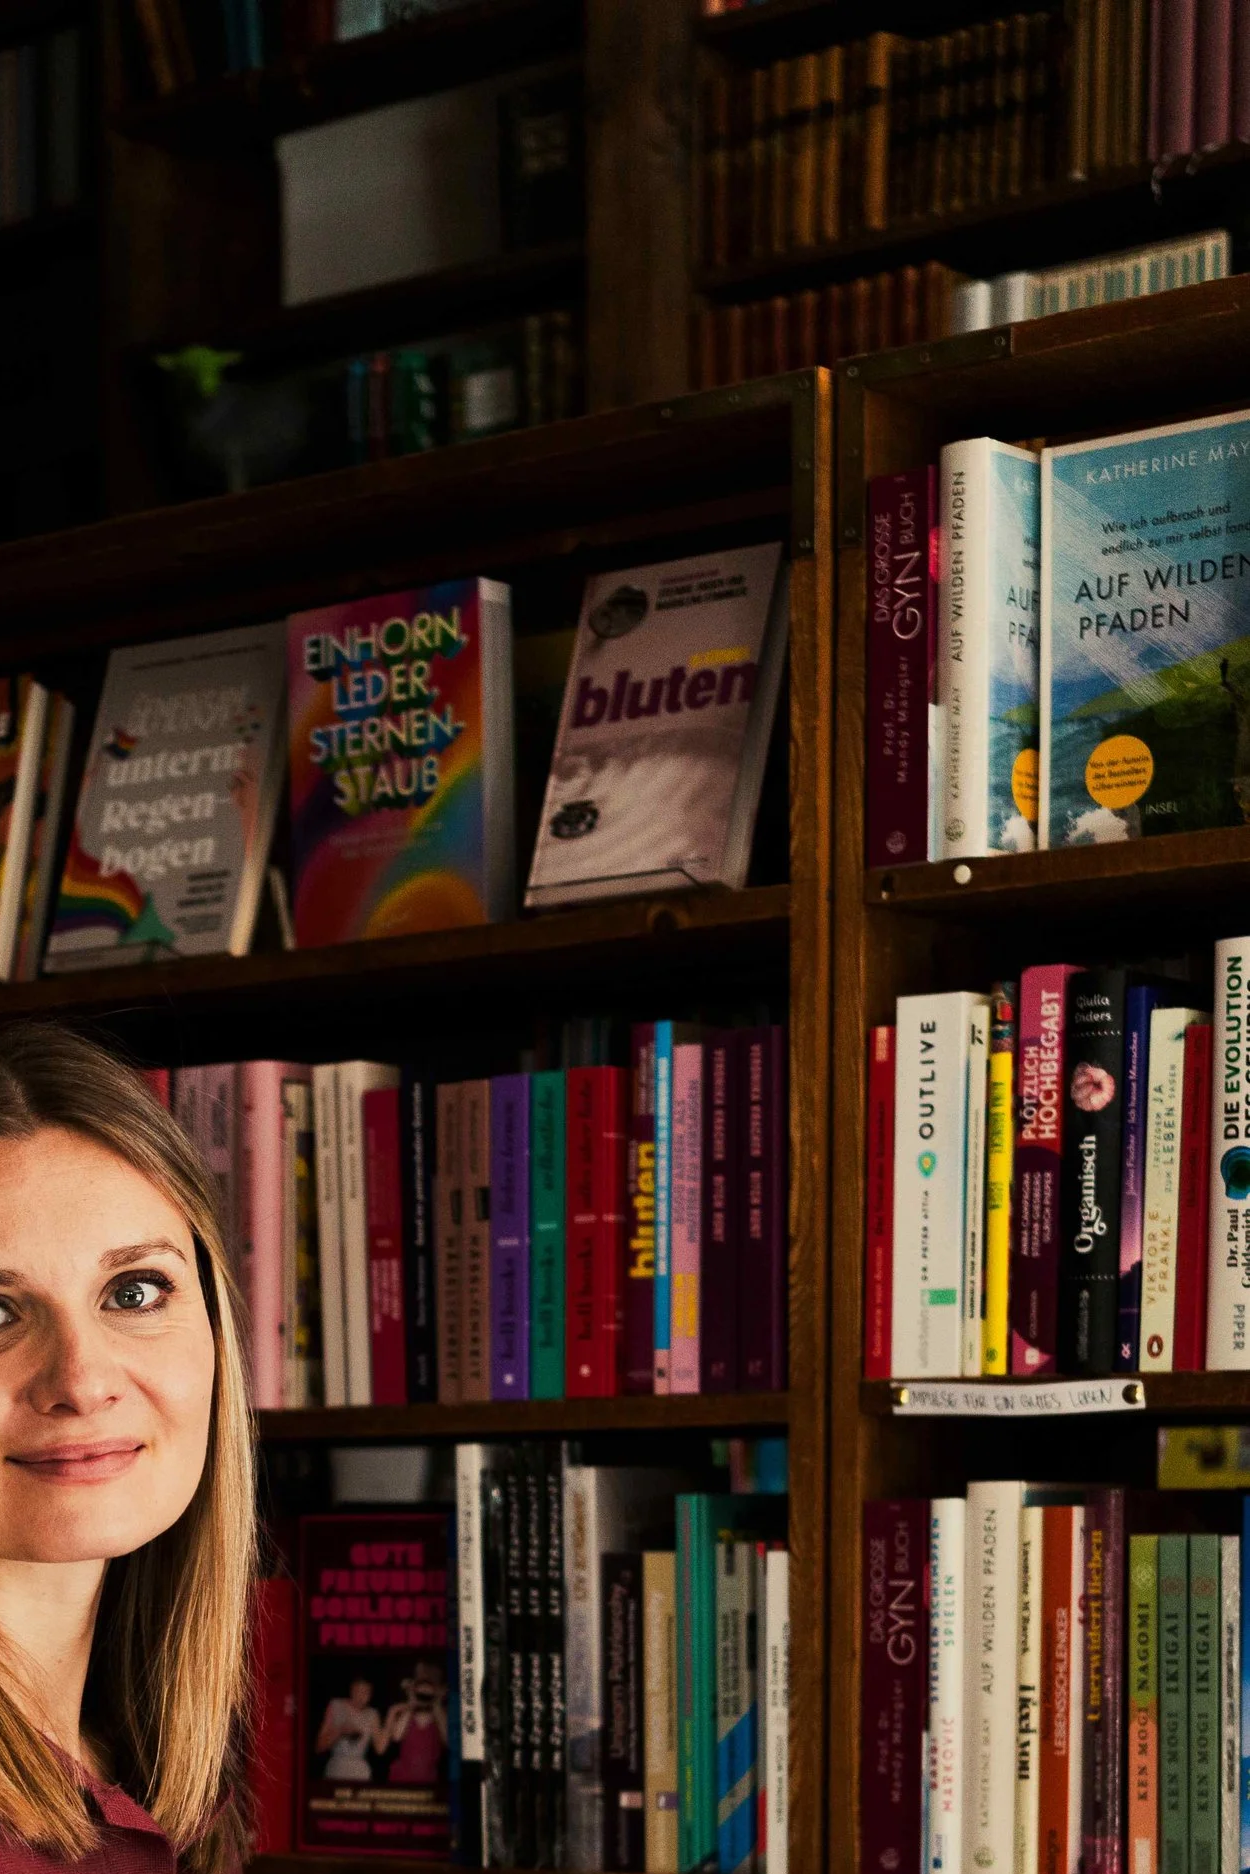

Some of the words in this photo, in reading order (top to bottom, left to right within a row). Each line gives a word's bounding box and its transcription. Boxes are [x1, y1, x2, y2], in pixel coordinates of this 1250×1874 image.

[1086, 449, 1198, 486] KATHERINE
[1209, 440, 1250, 463] MAY
[898, 489, 918, 547] BUCH
[950, 469, 964, 540] PFADEN
[1102, 520, 1126, 536] Wie
[1130, 515, 1147, 531] ich
[1152, 504, 1205, 529] aufbrach
[1208, 500, 1232, 516] und
[1189, 525, 1223, 542] selbst
[892, 549, 924, 641] GYN
[951, 550, 964, 628] WILDEN
[1075, 573, 1129, 604] AUF
[1144, 552, 1250, 591] WILDEN
[303, 604, 471, 672] EINHORN,
[1079, 599, 1190, 640] PFADEN
[952, 634, 964, 662] AUF
[333, 659, 442, 713] LEDER,
[573, 664, 762, 728] bluten
[107, 742, 247, 788] unterm
[332, 756, 441, 809] STAUB
[1145, 801, 1180, 816] INSEL
[99, 839, 216, 882] bogen
[1076, 993, 1111, 1009] Giulia
[1224, 956, 1243, 1095] EVOLUTION
[919, 1020, 937, 1139] OUTLIVE
[1039, 989, 1062, 1140] HOCHBEGABT
[1021, 1045, 1040, 1140] PLÖTZLICH
[1224, 1099, 1240, 1140] DIE
[1163, 1107, 1175, 1165] LEBEN
[627, 1140, 656, 1280] bluten
[1072, 1134, 1107, 1255] Organisch
[921, 1230, 929, 1263] PETER
[1159, 1214, 1170, 1293] FRANKL
[1226, 1207, 1239, 1246] Paul
[1147, 1231, 1158, 1305] VIKTOR
[1226, 1248, 1239, 1268] Dr.
[894, 1520, 909, 1573] BUCH
[983, 1508, 996, 1577] PFADEN
[1087, 1529, 1103, 1597] lieben
[886, 1579, 917, 1667] GYN
[943, 1574, 955, 1647] SPIELEN
[982, 1586, 994, 1657] WILDEN
[1137, 1601, 1151, 1695] NAGOMI
[1165, 1611, 1180, 1695] IKIGAI
[1196, 1611, 1211, 1695] IKIGAI
[981, 1666, 993, 1694] AUF
[1054, 1606, 1068, 1758] LEBENSSCHLENKER
[1018, 1697, 1037, 1736] feel
[1137, 1706, 1150, 1756] MOGI
[1165, 1711, 1179, 1765] MOGI
[1196, 1711, 1210, 1765] MOGI
[1017, 1740, 1034, 1781] you
[1137, 1762, 1150, 1802] KEN
[1165, 1770, 1178, 1812] KEN
[1196, 1769, 1209, 1813] KEN
